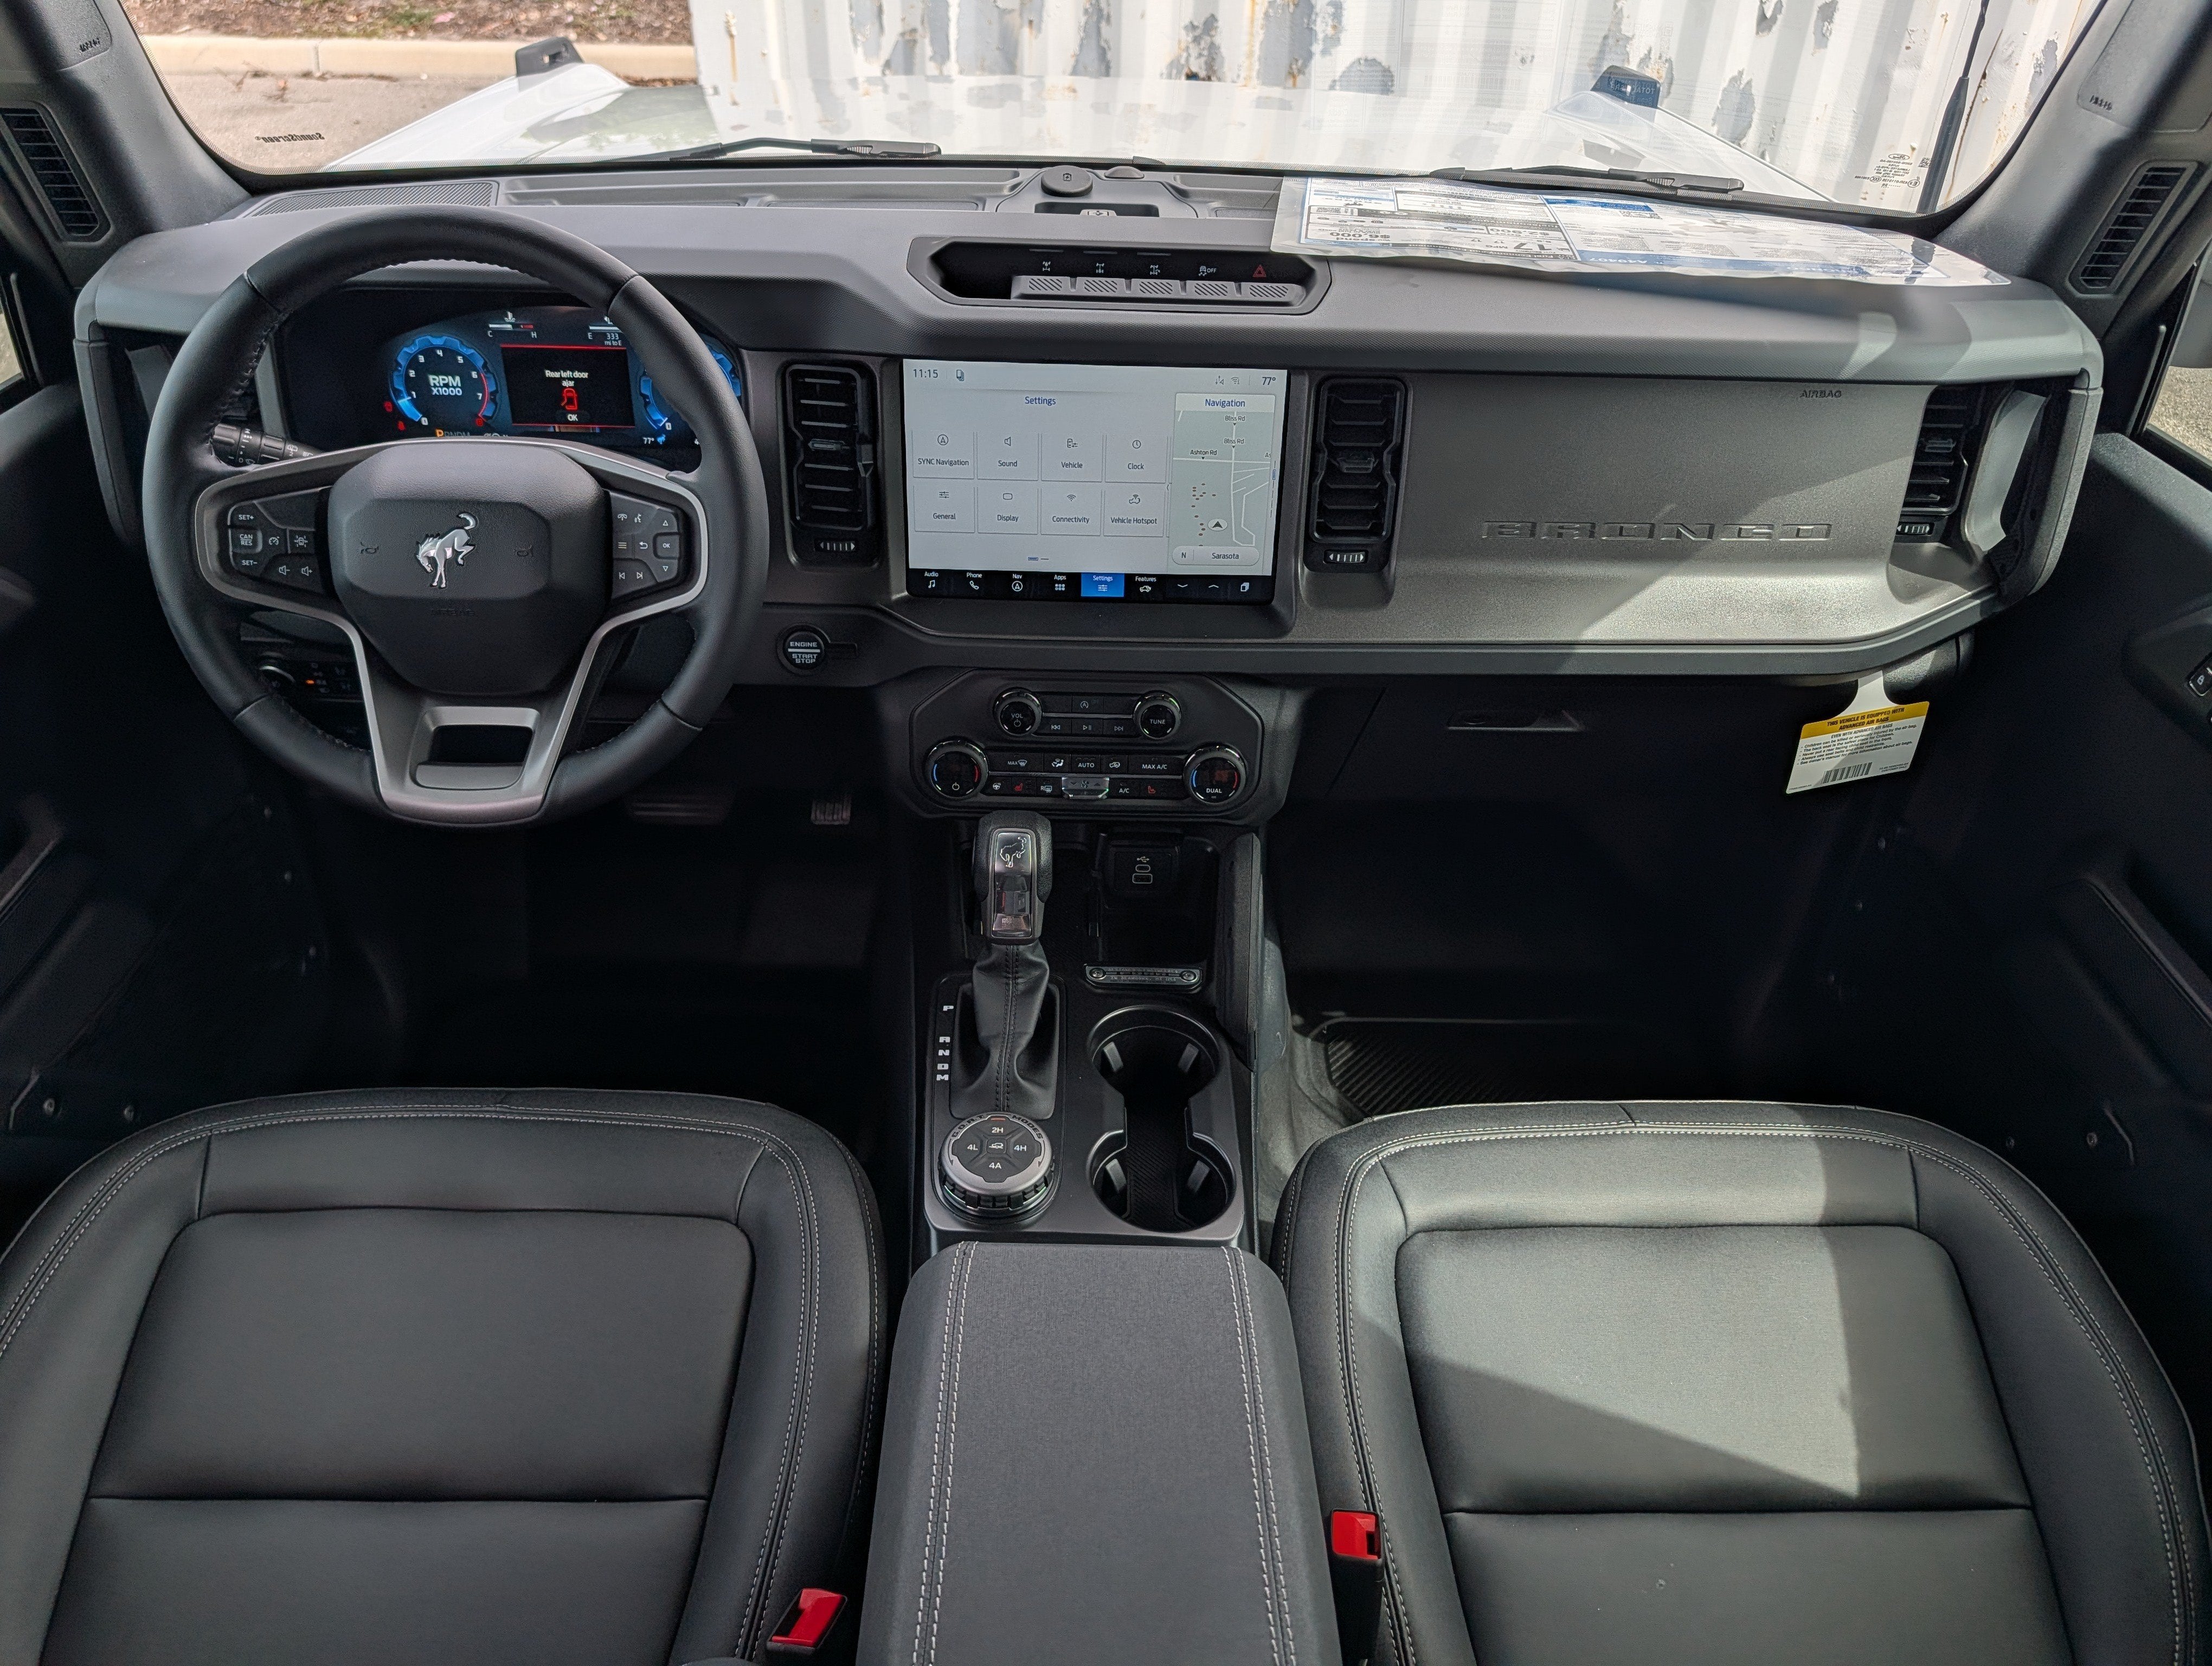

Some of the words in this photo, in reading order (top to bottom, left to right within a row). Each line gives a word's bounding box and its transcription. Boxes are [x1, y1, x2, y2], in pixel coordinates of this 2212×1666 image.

[1513, 242, 1552, 251] 17
[418, 355, 425, 363] 3
[409, 369, 415, 377] 2
[545, 370, 561, 378] Rear
[914, 368, 938, 379] 11:15
[428, 374, 461, 387] RPM
[1262, 377, 1276, 386] 77°
[432, 387, 462, 395] X1000
[1799, 389, 1842, 399] AIRBAG
[1025, 396, 1056, 406] Settings
[1205, 399, 1245, 408] Navigation
[421, 417, 428, 425] 0
[666, 422, 672, 431] 0
[918, 458, 935, 466] SYNC
[933, 512, 956, 521] General
[997, 514, 1019, 523] Display
[1052, 515, 1090, 524] Connectivity
[1110, 516, 1131, 524] Vehicle
[1133, 516, 1158, 526] Hotspot
[1482, 521, 1832, 542] BRONCO
[1840, 716, 1859, 724] VEHICLE
[1867, 710, 1891, 719] EQUIPPED
[1838, 722, 1865, 731] ADVANCED
[1012, 1115, 1044, 1139] MODES
